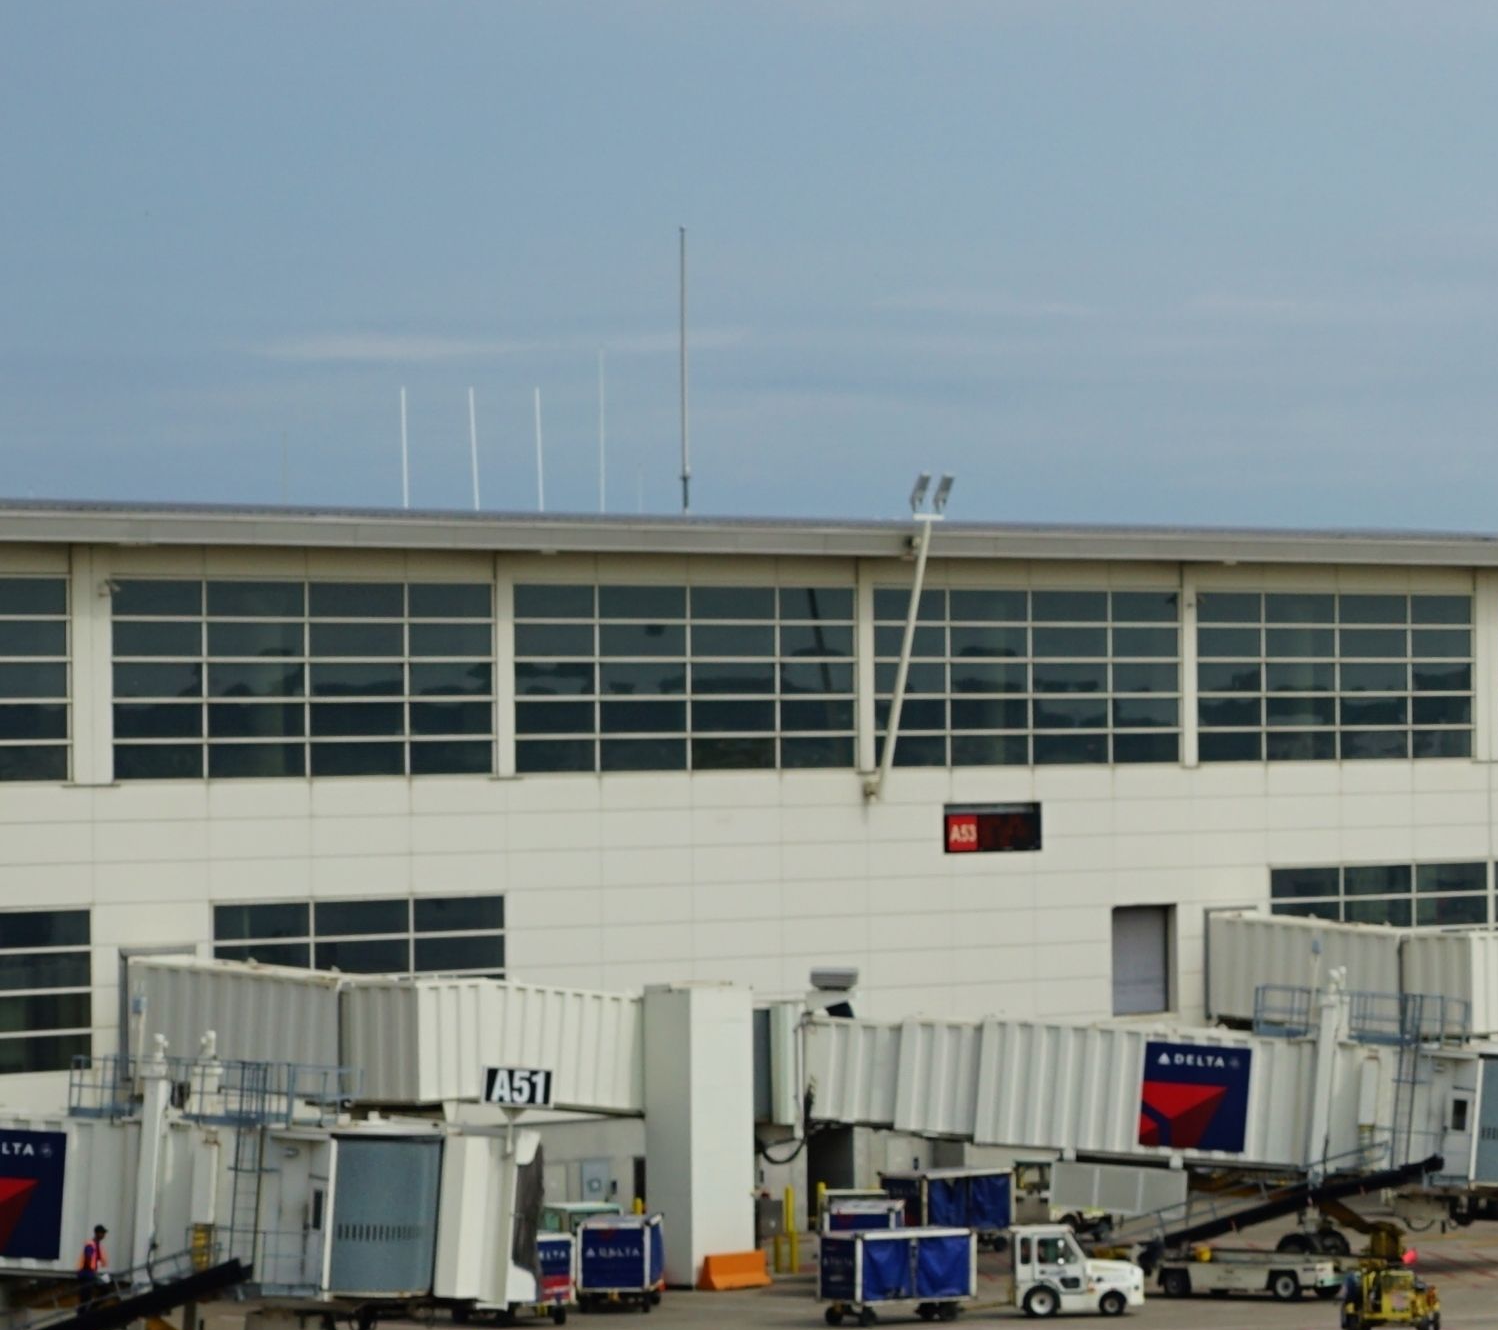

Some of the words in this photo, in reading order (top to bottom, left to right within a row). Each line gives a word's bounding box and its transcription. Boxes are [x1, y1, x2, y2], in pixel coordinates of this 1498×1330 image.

[950, 823, 977, 842] A53
[1173, 1052, 1225, 1068] DELTA
[490, 1069, 546, 1104] A51
[1, 1141, 35, 1156] LTA
[599, 1247, 640, 1259] DELTA
